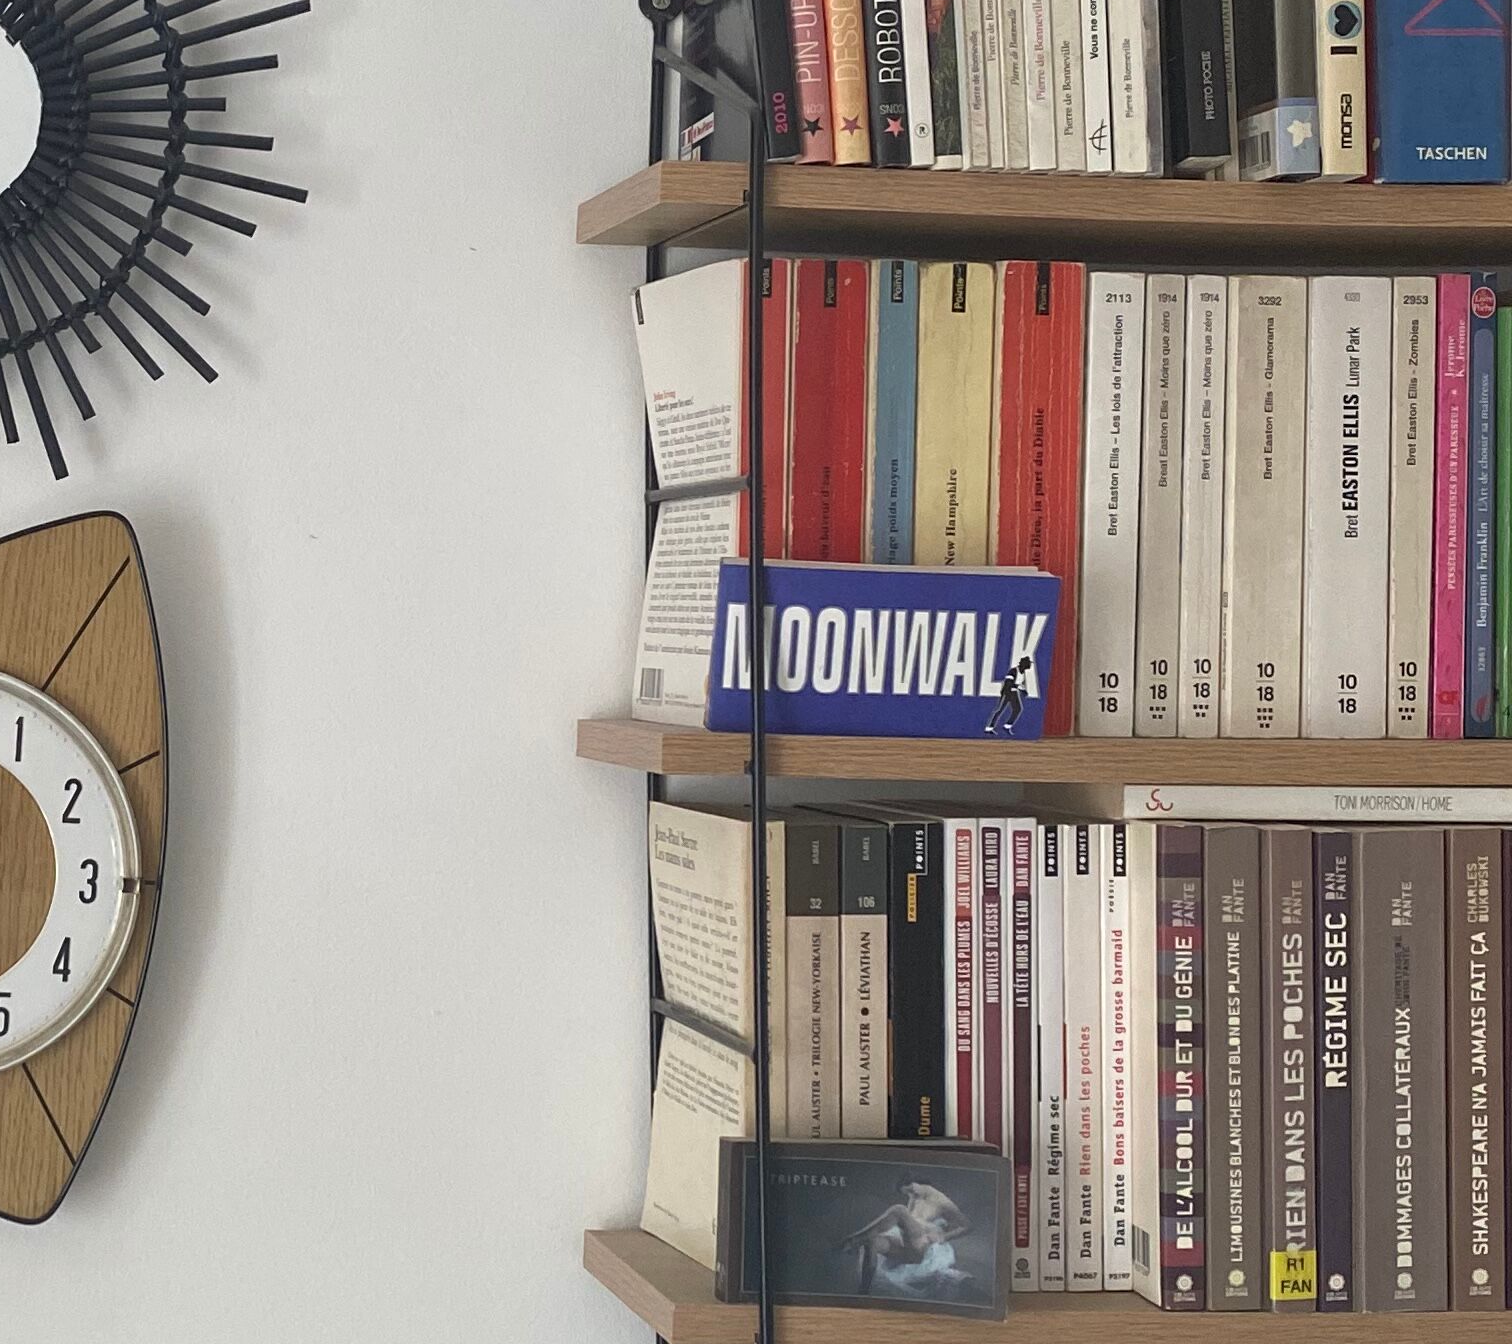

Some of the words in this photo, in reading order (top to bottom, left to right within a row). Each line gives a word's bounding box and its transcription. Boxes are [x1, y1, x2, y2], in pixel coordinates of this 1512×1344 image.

[1089, 38, 1099, 60] Vous
[1091, 21, 1099, 34] ne
[1340, 94, 1353, 150] monsa
[1416, 146, 1487, 161] TASCHEN
[1346, 327, 1361, 353] Park
[1345, 356, 1360, 388] Lunar
[1342, 394, 1360, 438] ELLIS
[1109, 447, 1120, 469] Ellis
[1342, 443, 1359, 511] EASTON
[947, 467, 959, 537] Hampshire
[1109, 472, 1120, 510] Easton
[1108, 514, 1119, 536] Bret
[1344, 514, 1358, 539] Bret
[1476, 522, 1487, 570] Franklin
[1475, 573, 1489, 628] Benjamin
[722, 602, 1049, 698] MOONWALK
[1337, 674, 1357, 689] 10
[1337, 698, 1357, 713] 18
[14, 716, 24, 762] 1
[61, 777, 83, 824] 2
[1334, 795, 1358, 810] TONI
[77, 858, 99, 904] 3
[52, 936, 71, 982] 4
[1325, 912, 1347, 967] SEC
[1471, 932, 1491, 955] ÇA
[1171, 936, 1193, 998] GÉNIE
[1283, 933, 1304, 1039] POCHES
[1471, 960, 1488, 1002] FAIT
[1175, 1004, 1193, 1032] DU
[1320, 976, 1348, 1088] RÉGIME
[1175, 1037, 1193, 1064] ET
[1471, 1008, 1489, 1078] JAMAIS
[1175, 1070, 1193, 1112] DUR
[1391, 1007, 1413, 1149] COLLATÉRAUX
[1471, 1083, 1489, 1109] N'A
[1175, 1119, 1193, 1216] L'ALCOOL
[1471, 1114, 1489, 1256] SHAKESPEARE
[1396, 1155, 1414, 1268] DOMMAGES
[1176, 1221, 1193, 1250] DE
